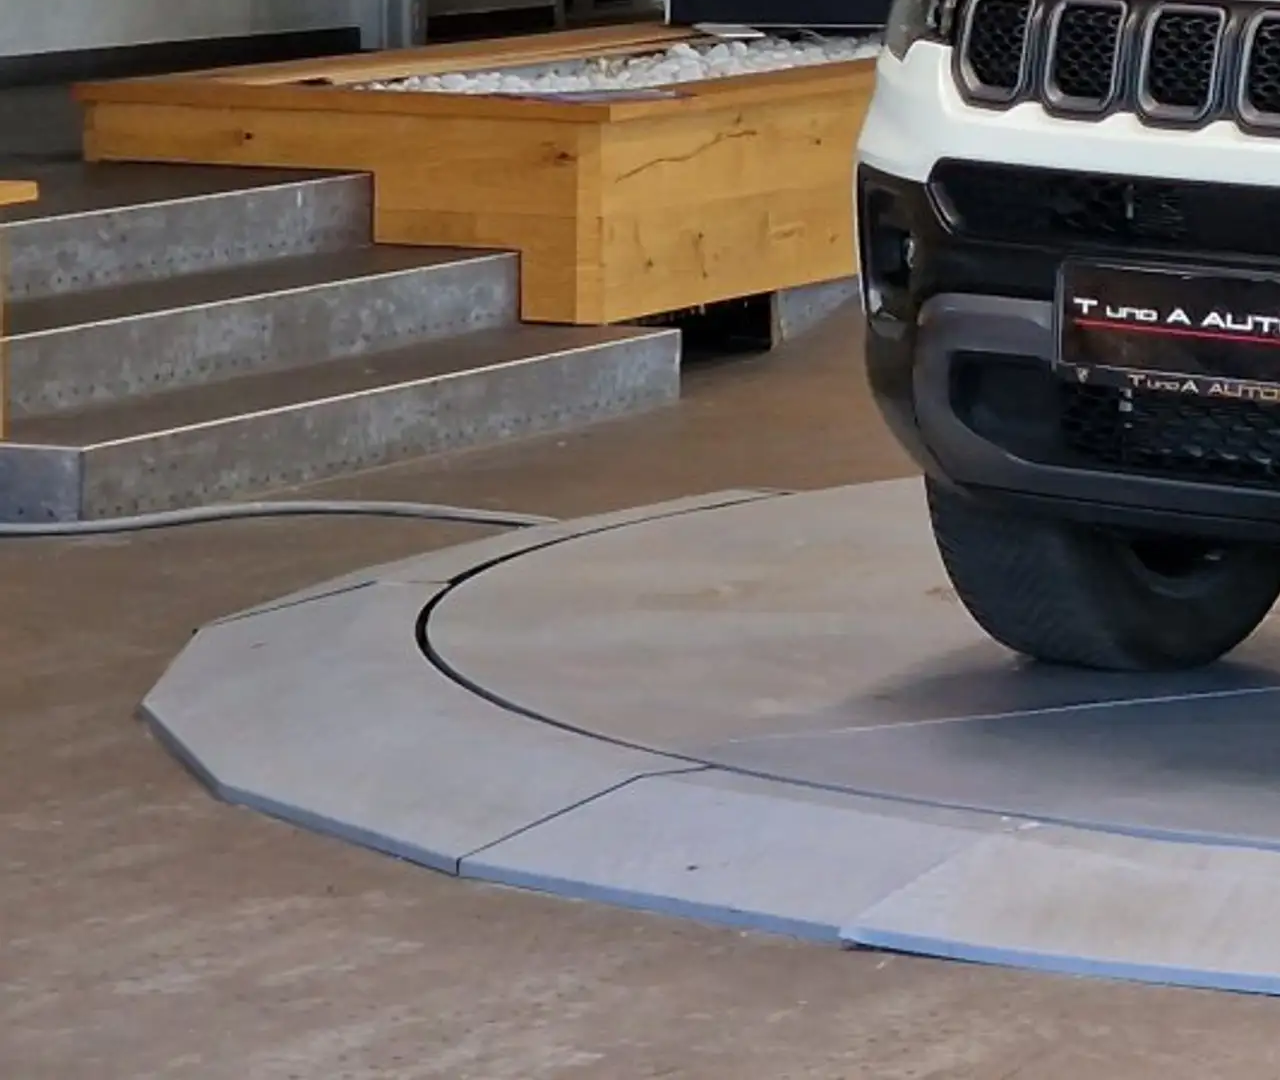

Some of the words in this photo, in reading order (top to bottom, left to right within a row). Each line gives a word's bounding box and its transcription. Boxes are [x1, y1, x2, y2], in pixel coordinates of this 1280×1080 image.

[1073, 297, 1098, 315] T
[1166, 307, 1192, 325] A
[1128, 373, 1146, 387] T
[1181, 379, 1200, 394] A
